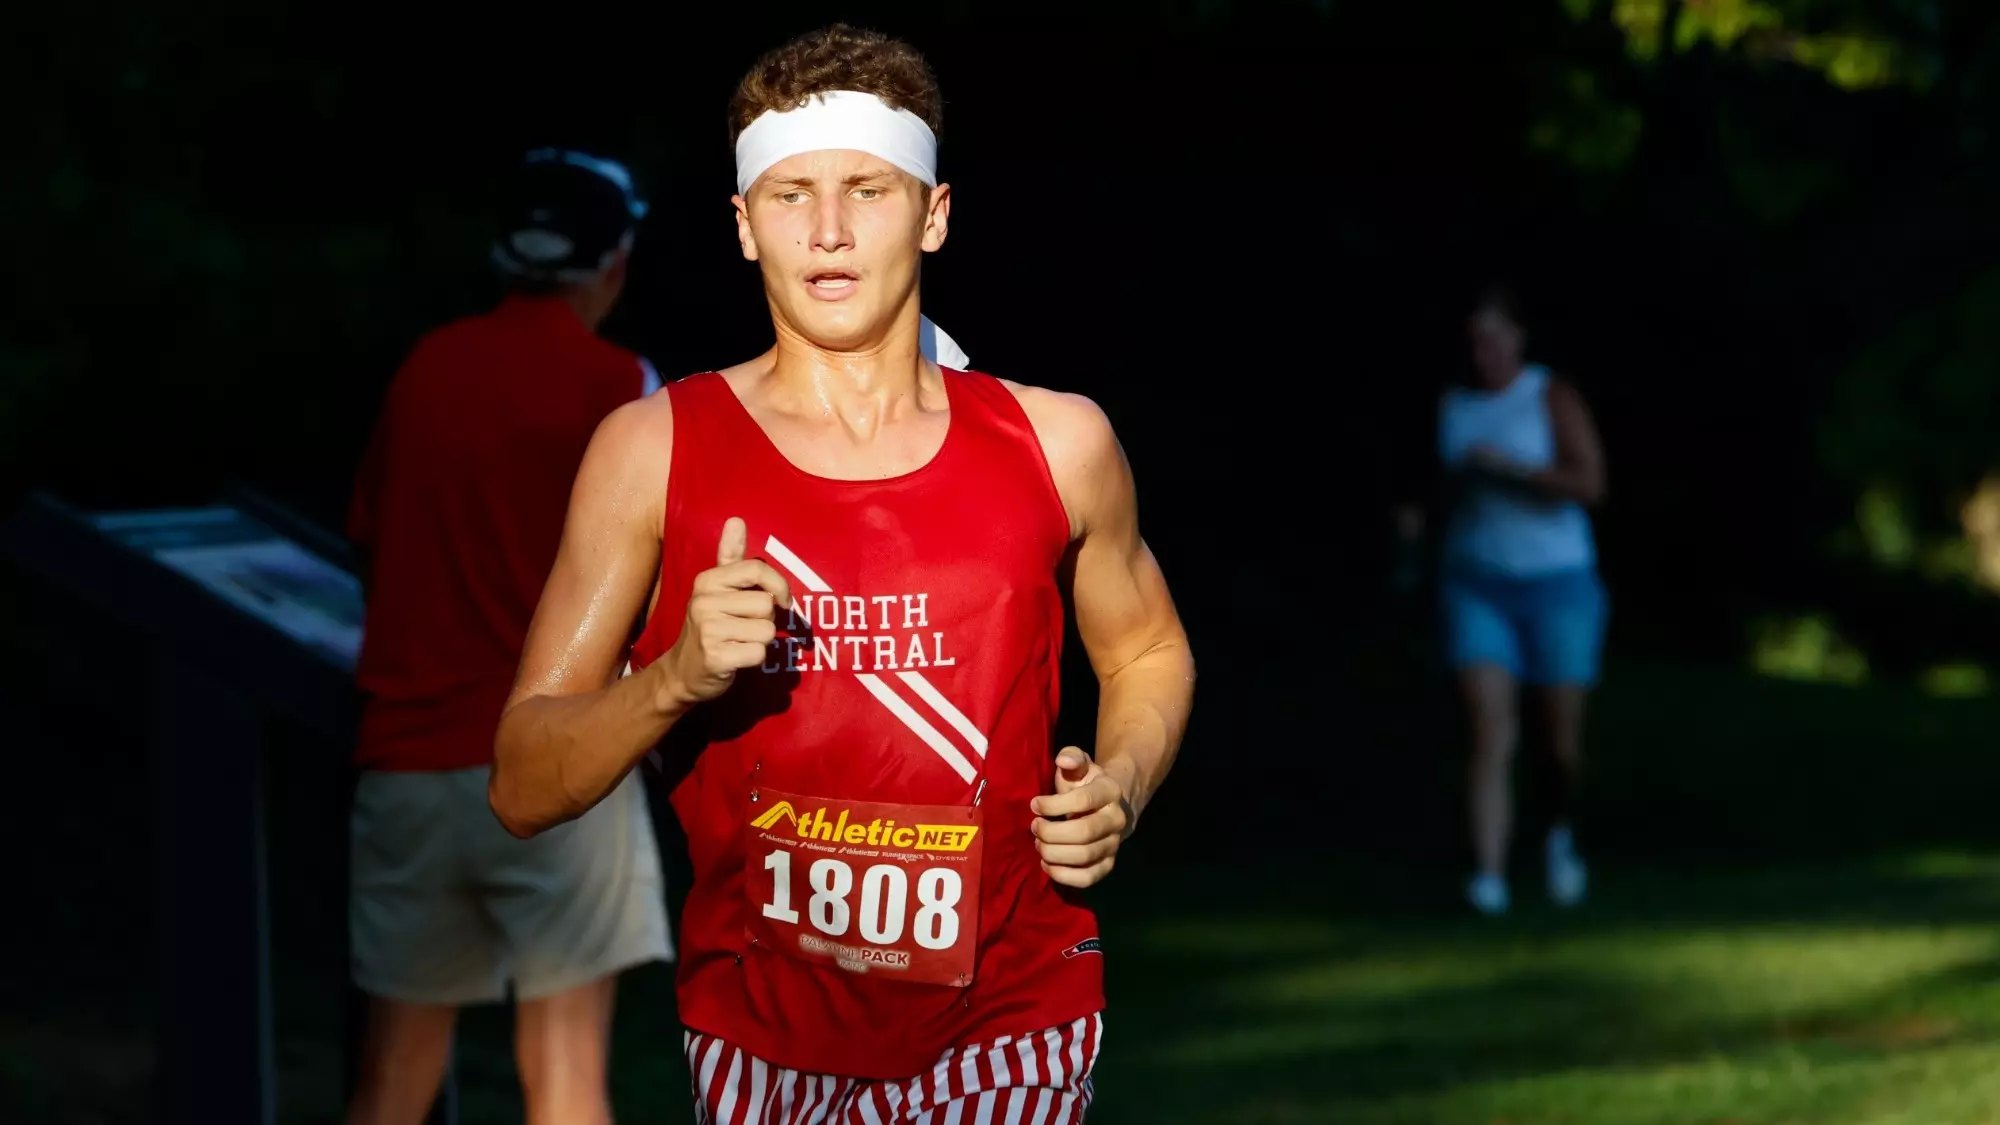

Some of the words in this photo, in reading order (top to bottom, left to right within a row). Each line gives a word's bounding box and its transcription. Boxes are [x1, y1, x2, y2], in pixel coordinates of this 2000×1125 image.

[786, 593, 929, 631] NORTH
[760, 631, 956, 674] CENTRAL
[762, 849, 962, 950] 1808
[861, 949, 908, 966] PACK
